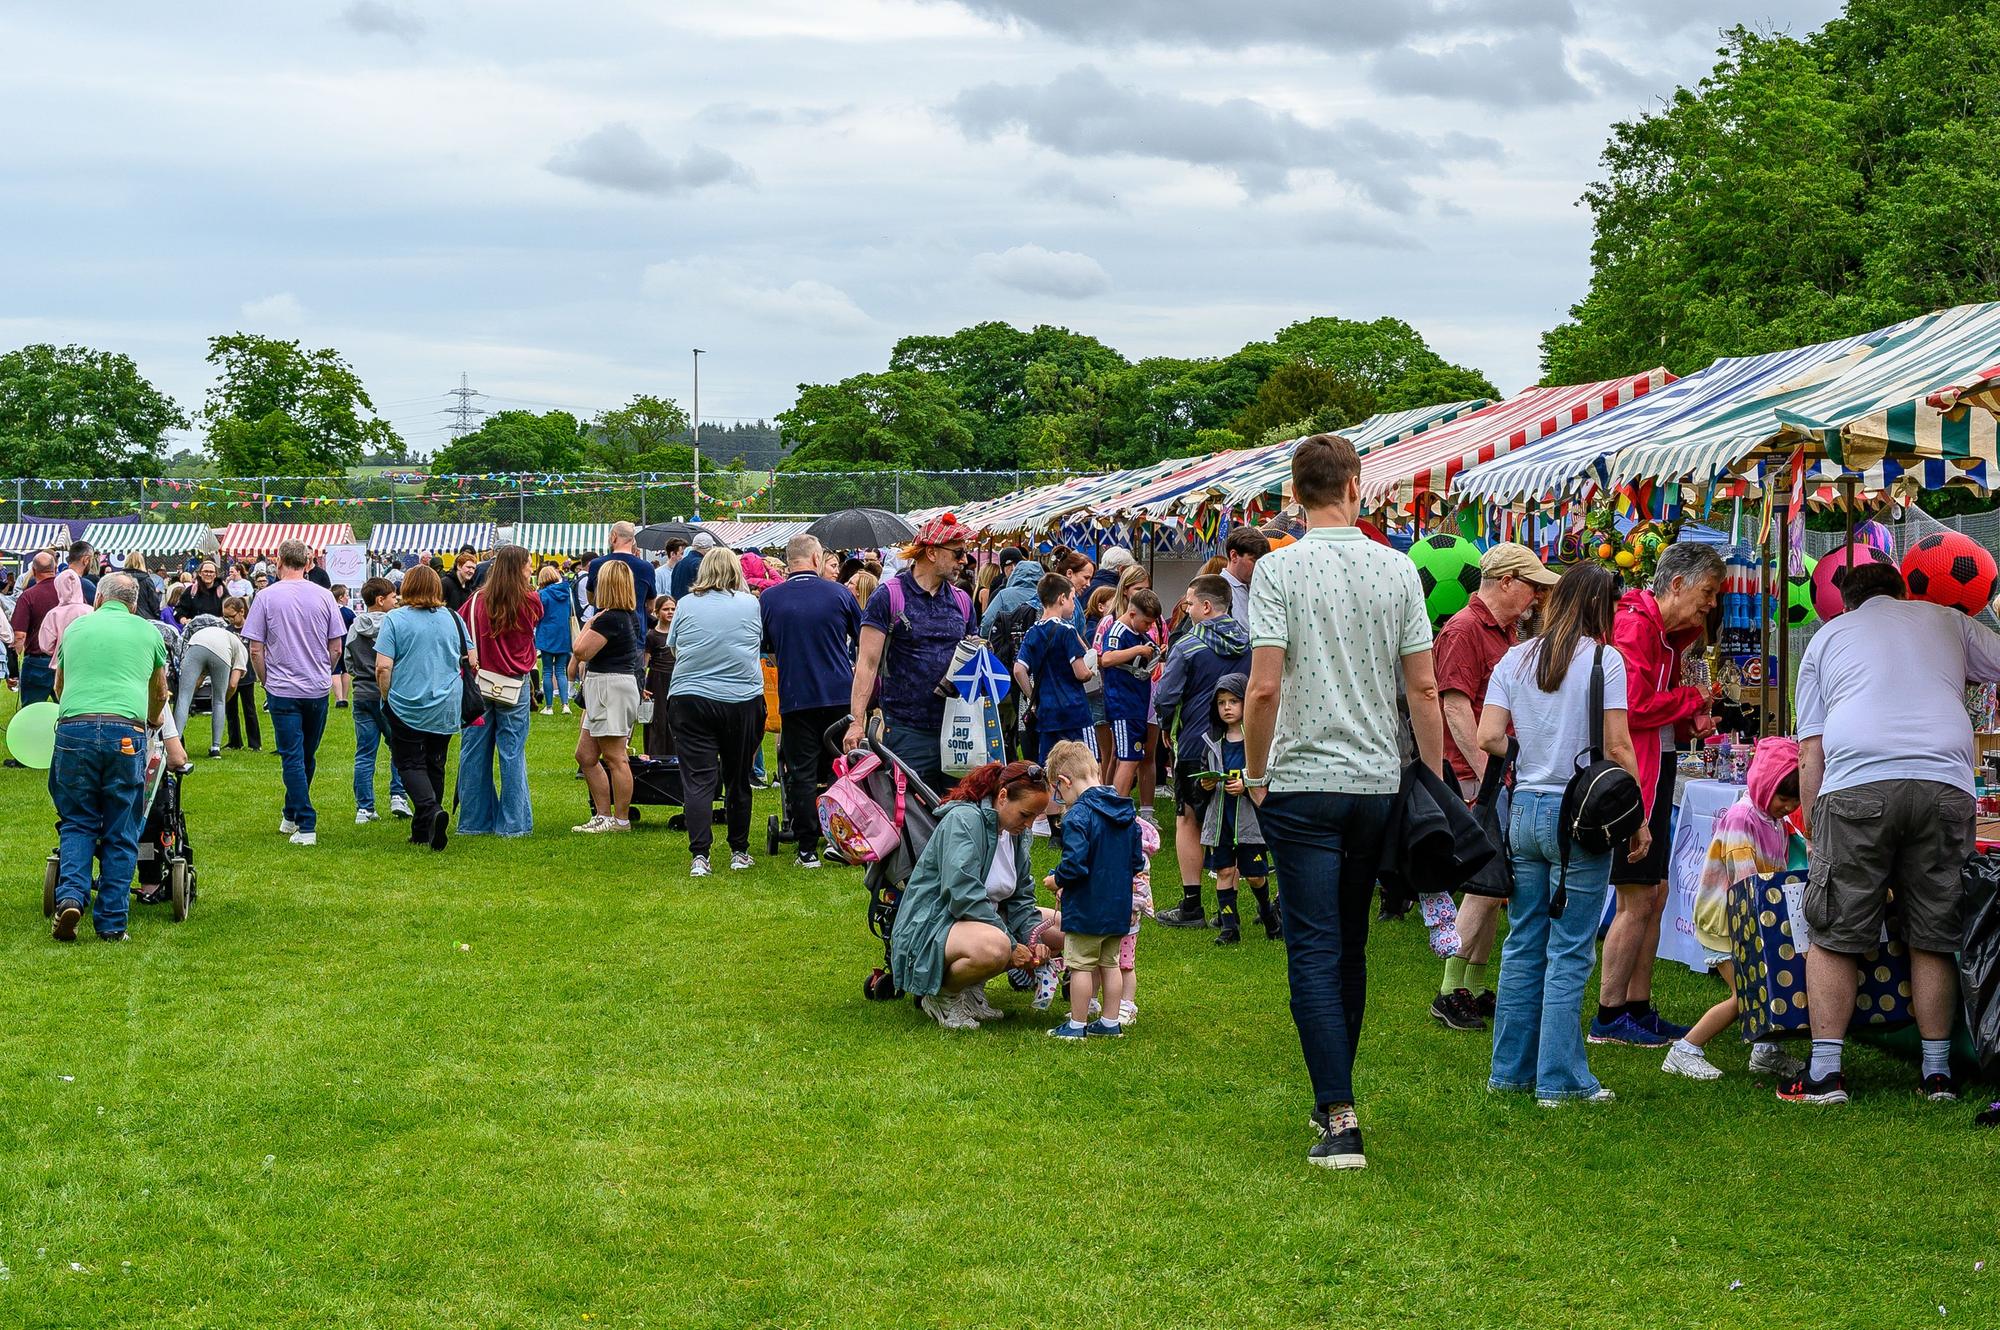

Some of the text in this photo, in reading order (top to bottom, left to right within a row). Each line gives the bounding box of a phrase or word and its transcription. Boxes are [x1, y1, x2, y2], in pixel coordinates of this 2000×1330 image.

[948, 739, 973, 750] some
[954, 750, 968, 764] joy
[1675, 917, 1695, 936] CREAT
